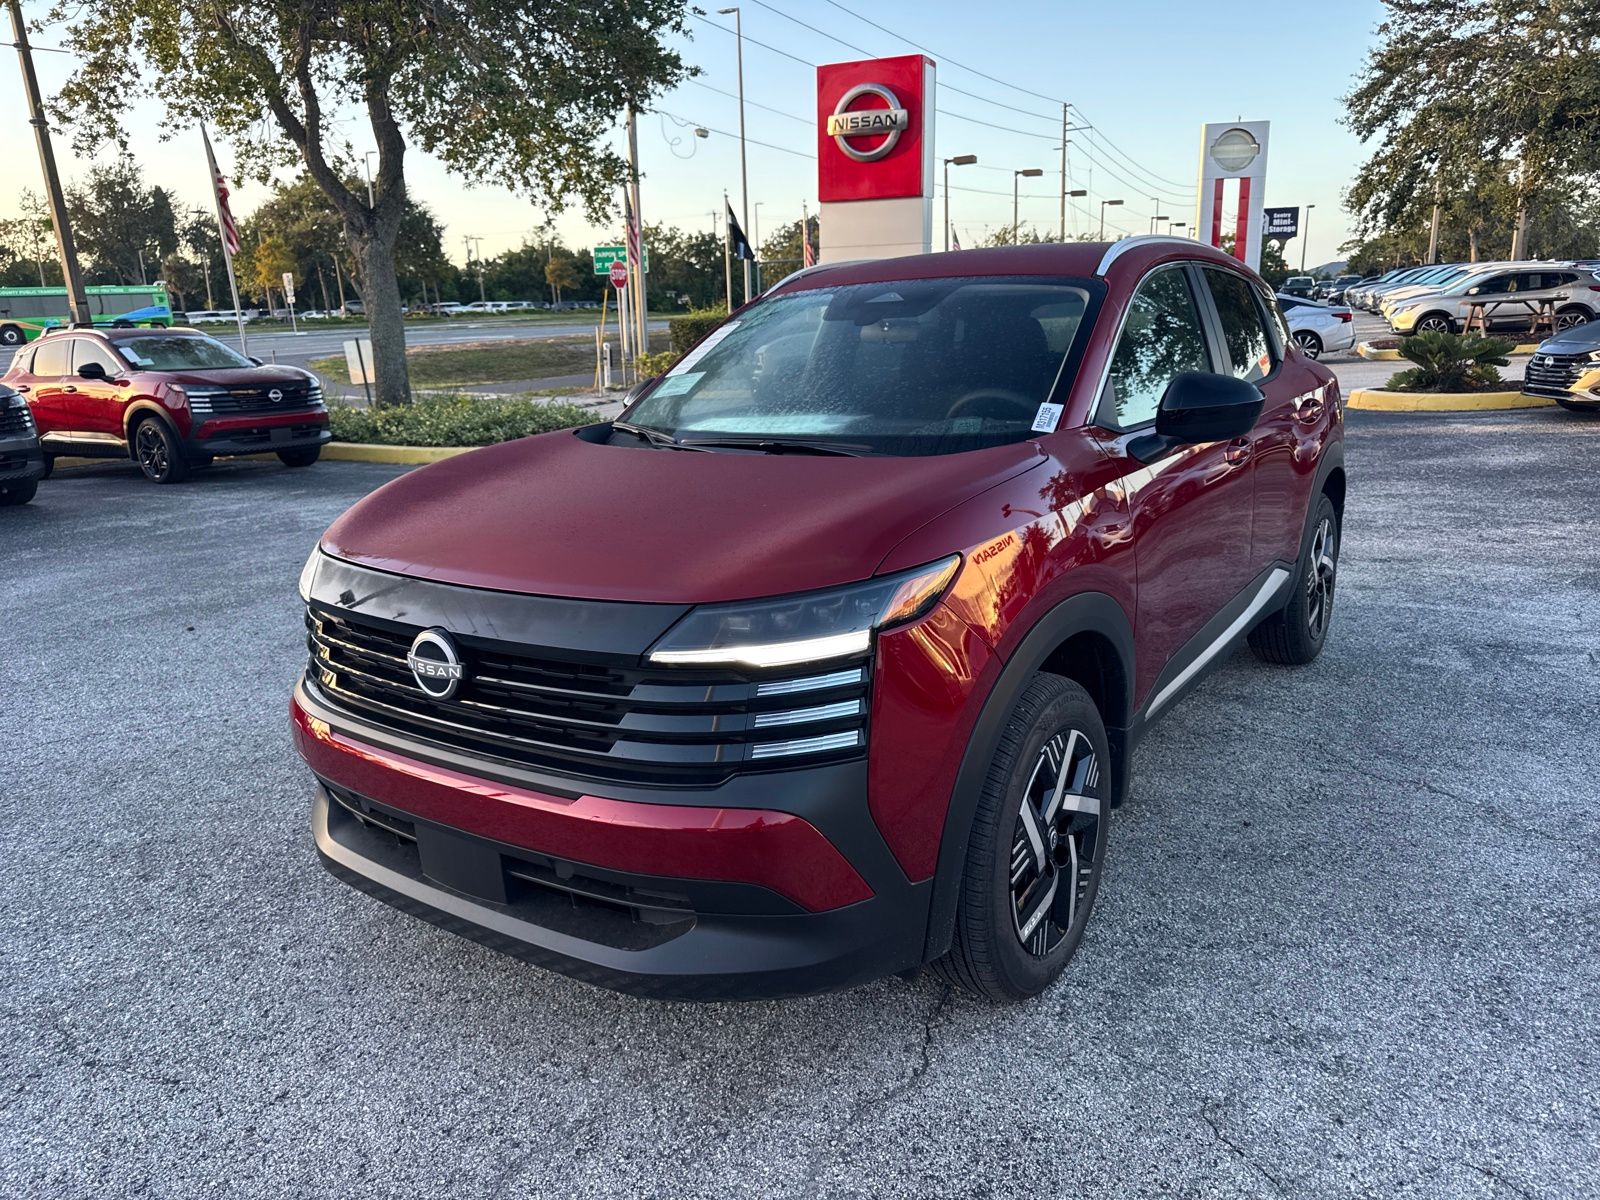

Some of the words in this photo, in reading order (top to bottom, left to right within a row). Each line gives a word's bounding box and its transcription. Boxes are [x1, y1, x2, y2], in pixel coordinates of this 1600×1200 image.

[834, 114, 897, 131] NISSAN
[1268, 225, 1296, 233] Storage
[611, 269, 626, 280] STOP
[408, 656, 460, 678] NISSAN
